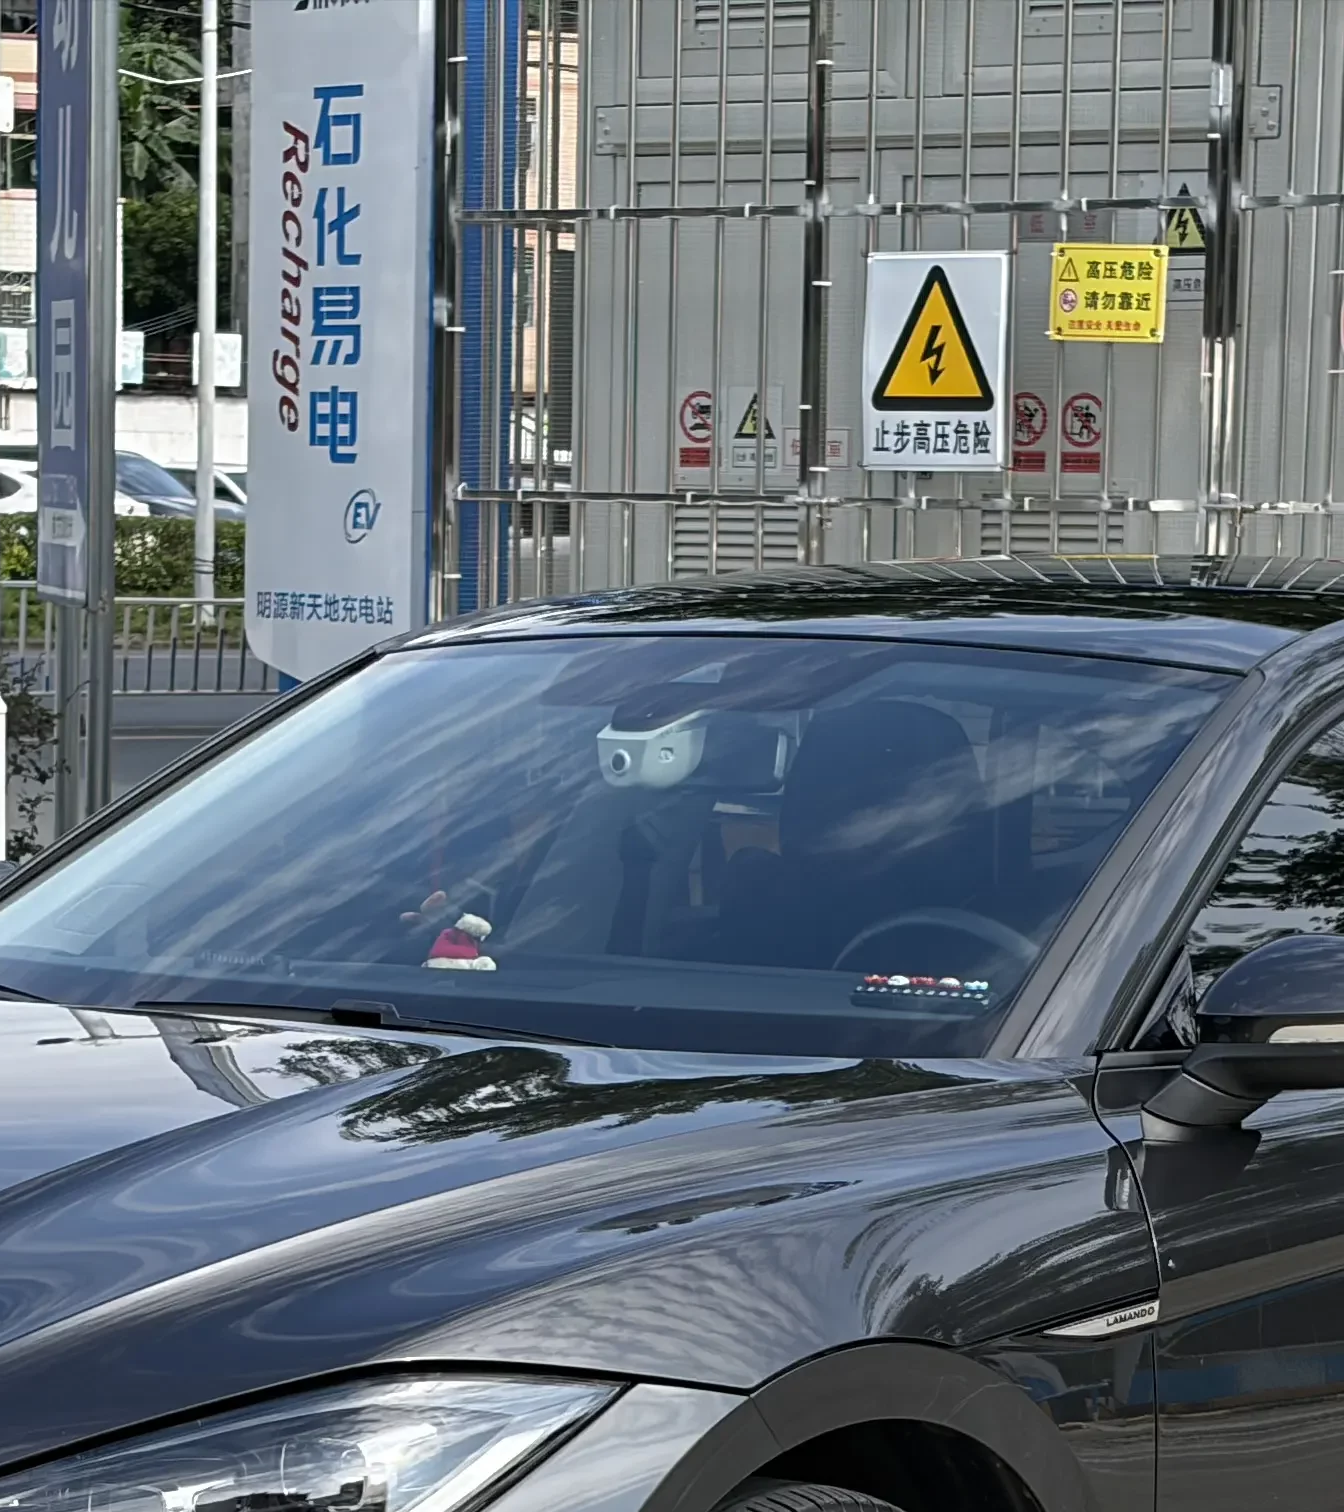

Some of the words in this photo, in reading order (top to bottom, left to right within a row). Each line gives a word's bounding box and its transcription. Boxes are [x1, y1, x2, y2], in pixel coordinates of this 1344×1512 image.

[272, 121, 313, 432] Recharge
[309, 85, 364, 464] 石化易电
[1086, 261, 1154, 281] 高压危险
[1084, 291, 1152, 311] 请勿靠近
[873, 420, 991, 455] 止步高压危险
[351, 502, 381, 529] EV
[256, 591, 394, 625] 明源新天地充电站
[1105, 1306, 1156, 1328] LAMANDO
